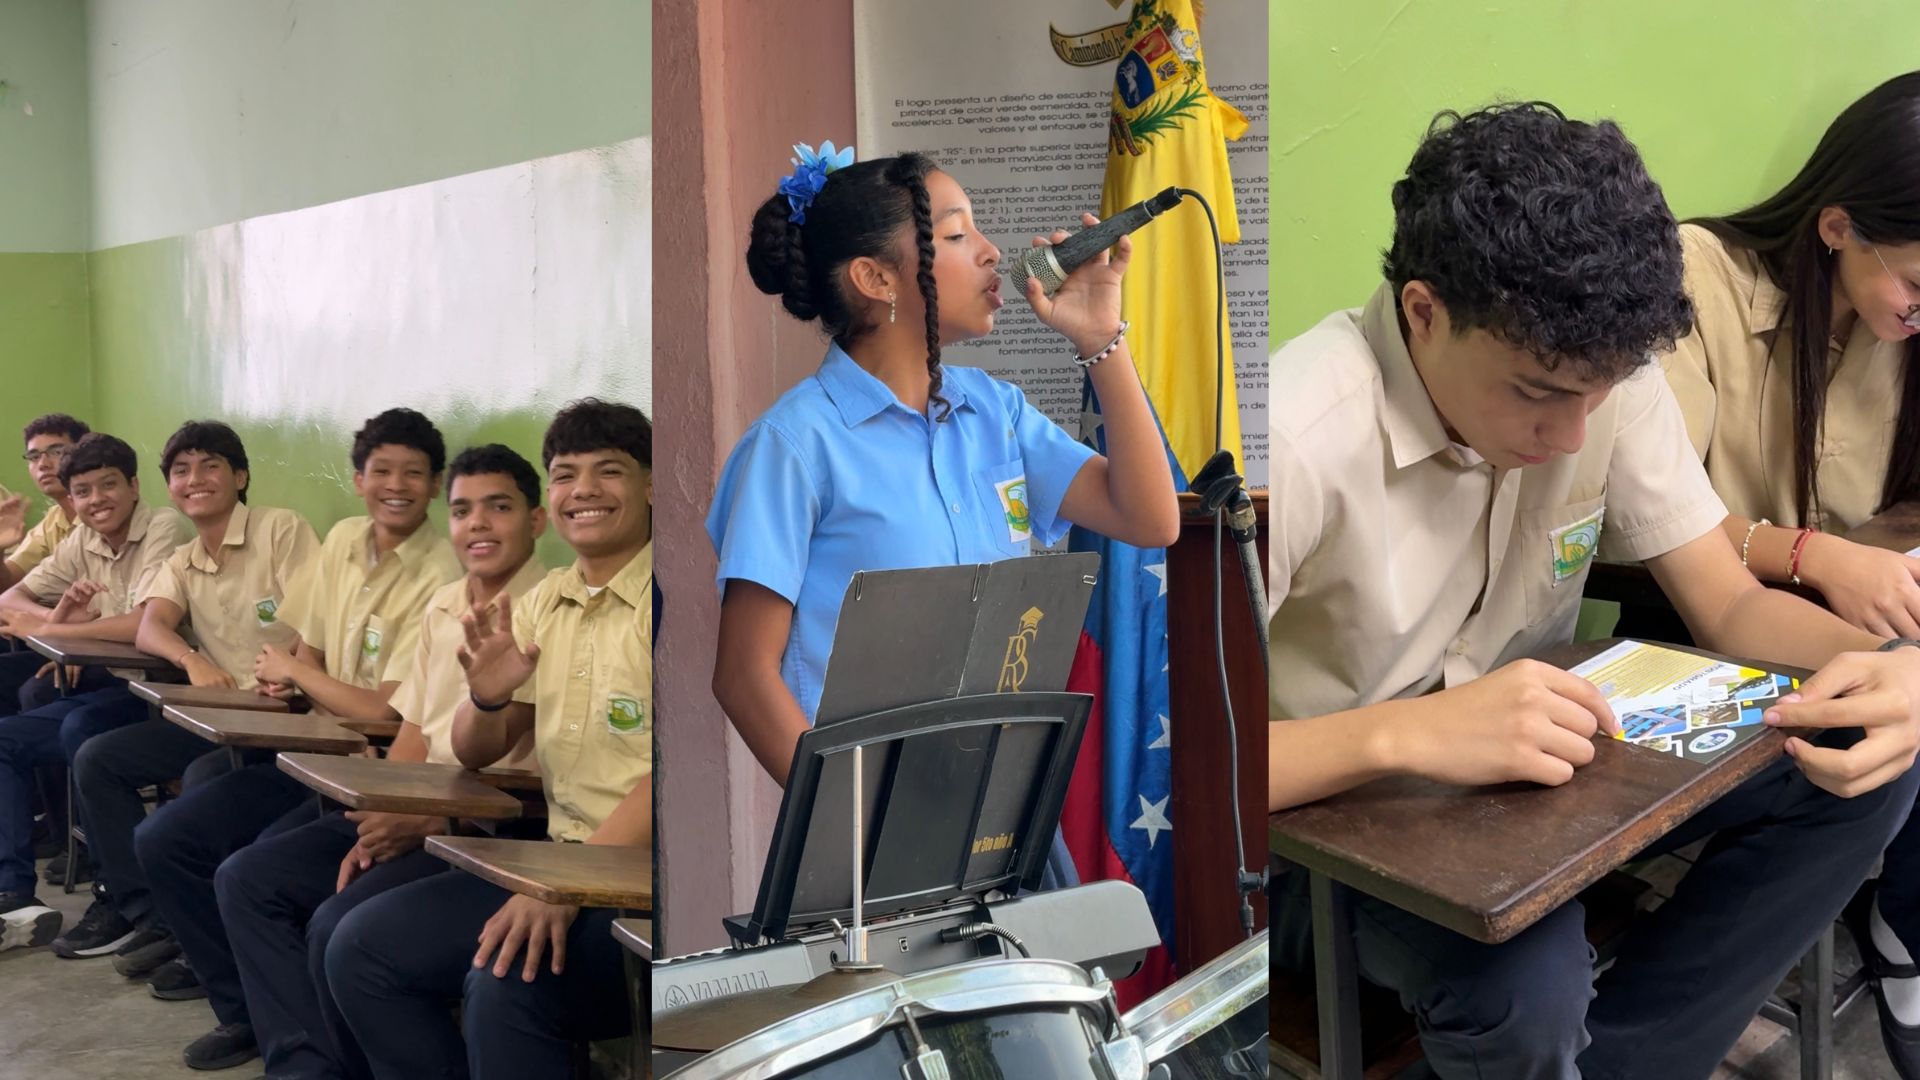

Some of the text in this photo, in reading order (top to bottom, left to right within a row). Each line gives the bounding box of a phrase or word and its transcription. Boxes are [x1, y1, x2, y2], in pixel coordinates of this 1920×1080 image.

[895, 99, 904, 107] El
[907, 99, 931, 107] logo
[934, 97, 981, 106] presenta
[1000, 93, 1035, 102] diseño
[1039, 92, 1053, 100] de
[1056, 91, 1098, 100] escudo
[900, 107, 947, 117] principal
[949, 107, 964, 115] de
[966, 106, 994, 114] color
[995, 104, 1028, 112] verde
[957, 116, 993, 125] Dentro
[995, 115, 1010, 123] de
[1012, 114, 1036, 122] este
[978, 125, 1016, 134] valores
[1040, 123, 1087, 131] enfoque
[1089, 121, 1104, 129] de
[969, 147, 983, 155] En
[998, 145, 1027, 154] parte
[1029, 144, 1071, 152] superior
[978, 156, 1006, 164] letras
[1010, 165, 1054, 173] nombre
[1056, 163, 1071, 171] de
[1074, 162, 1084, 170] la
[1041, 184, 1068, 193] lugar
[1005, 195, 1035, 203] tonos
[1088, 192, 1101, 200] La
[1025, 205, 1073, 213] menudo
[1244, 196, 1261, 205] de
[997, 217, 1011, 225] Su
[1013, 214, 1068, 224] ubicación
[982, 227, 1009, 235] color
[1011, 226, 1053, 234] dorado
[1243, 248, 1267, 257] que
[1242, 320, 1257, 328] las
[1004, 338, 1018, 346] un
[1020, 335, 1067, 346] enfoque
[998, 345, 1066, 356] fomentando
[1245, 361, 1259, 369] se
[1024, 376, 1071, 386] universal
[1050, 388, 1076, 396] para
[1243, 381, 1254, 389] la
[1250, 402, 1266, 410] de
